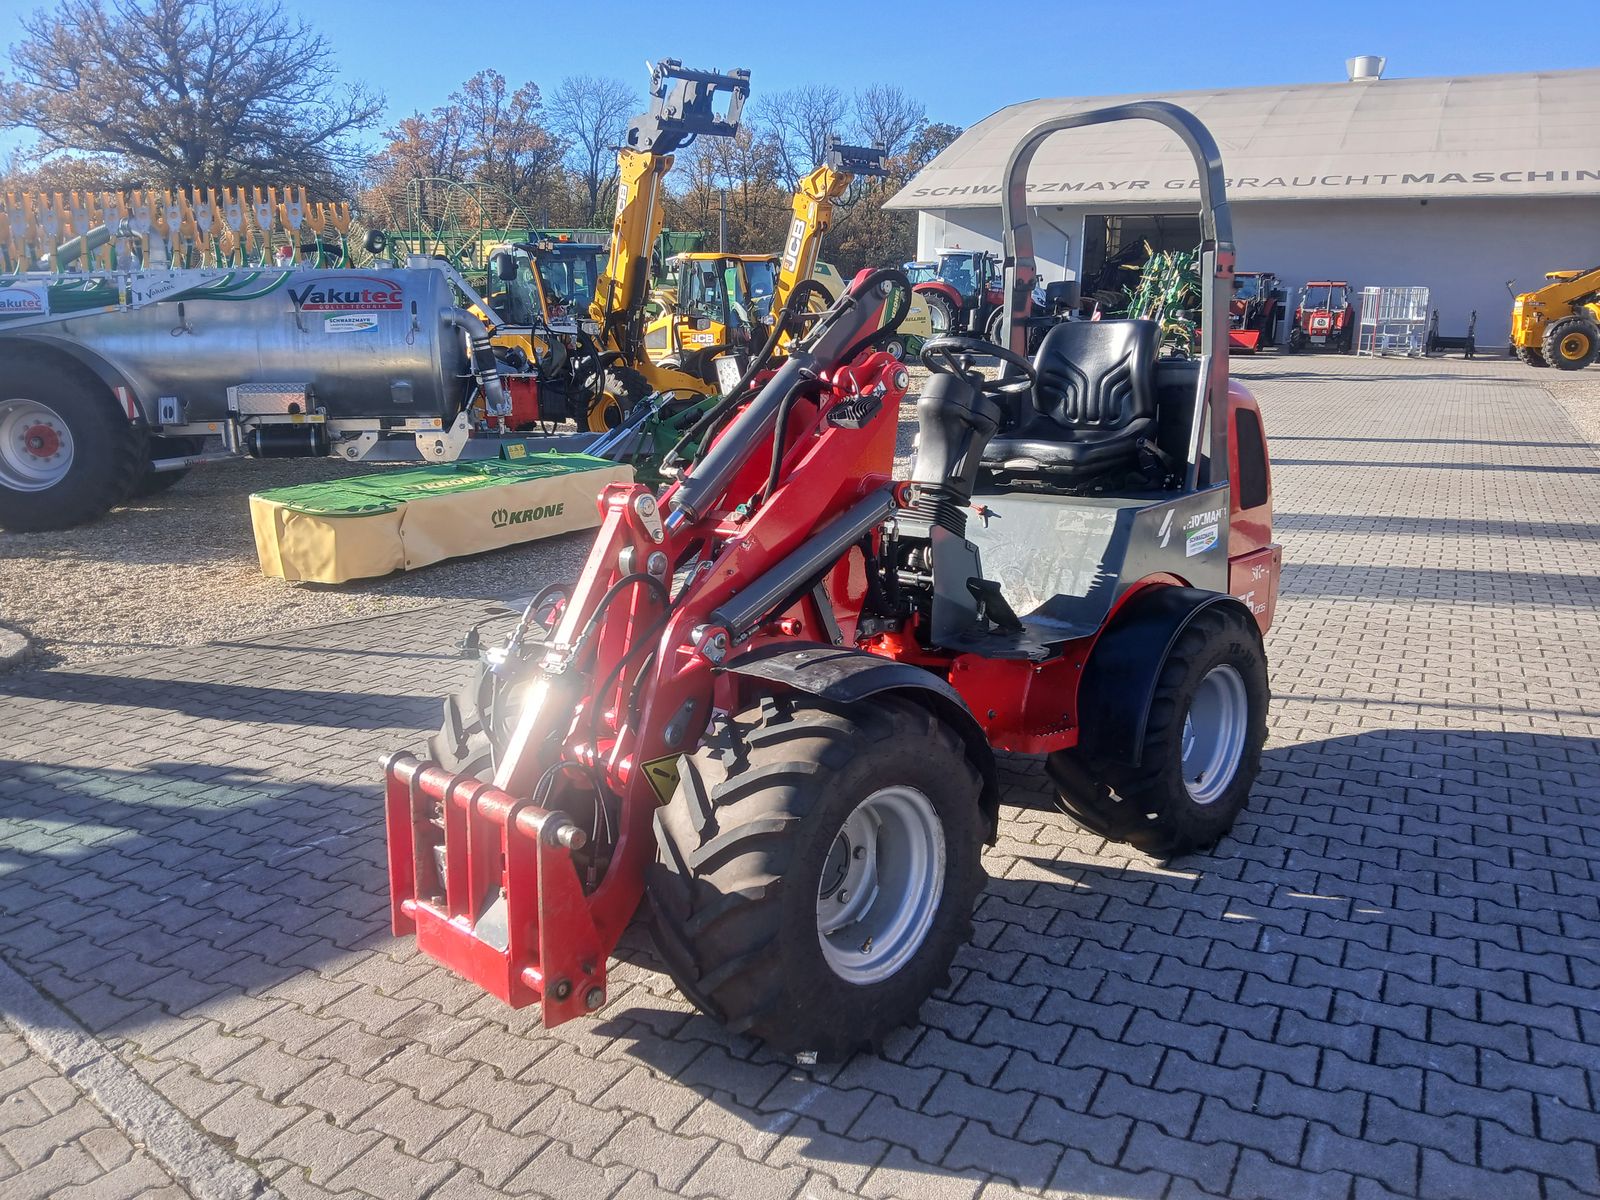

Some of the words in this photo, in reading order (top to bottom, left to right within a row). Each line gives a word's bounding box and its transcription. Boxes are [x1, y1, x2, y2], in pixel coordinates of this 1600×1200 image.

[912, 178, 1150, 198] SCHWRZMAYR
[783, 219, 807, 272] JCB
[0, 299, 42, 309] akutec
[287, 284, 403, 310] Vakutec
[691, 333, 714, 343] JCB
[509, 502, 564, 525] KRONE
